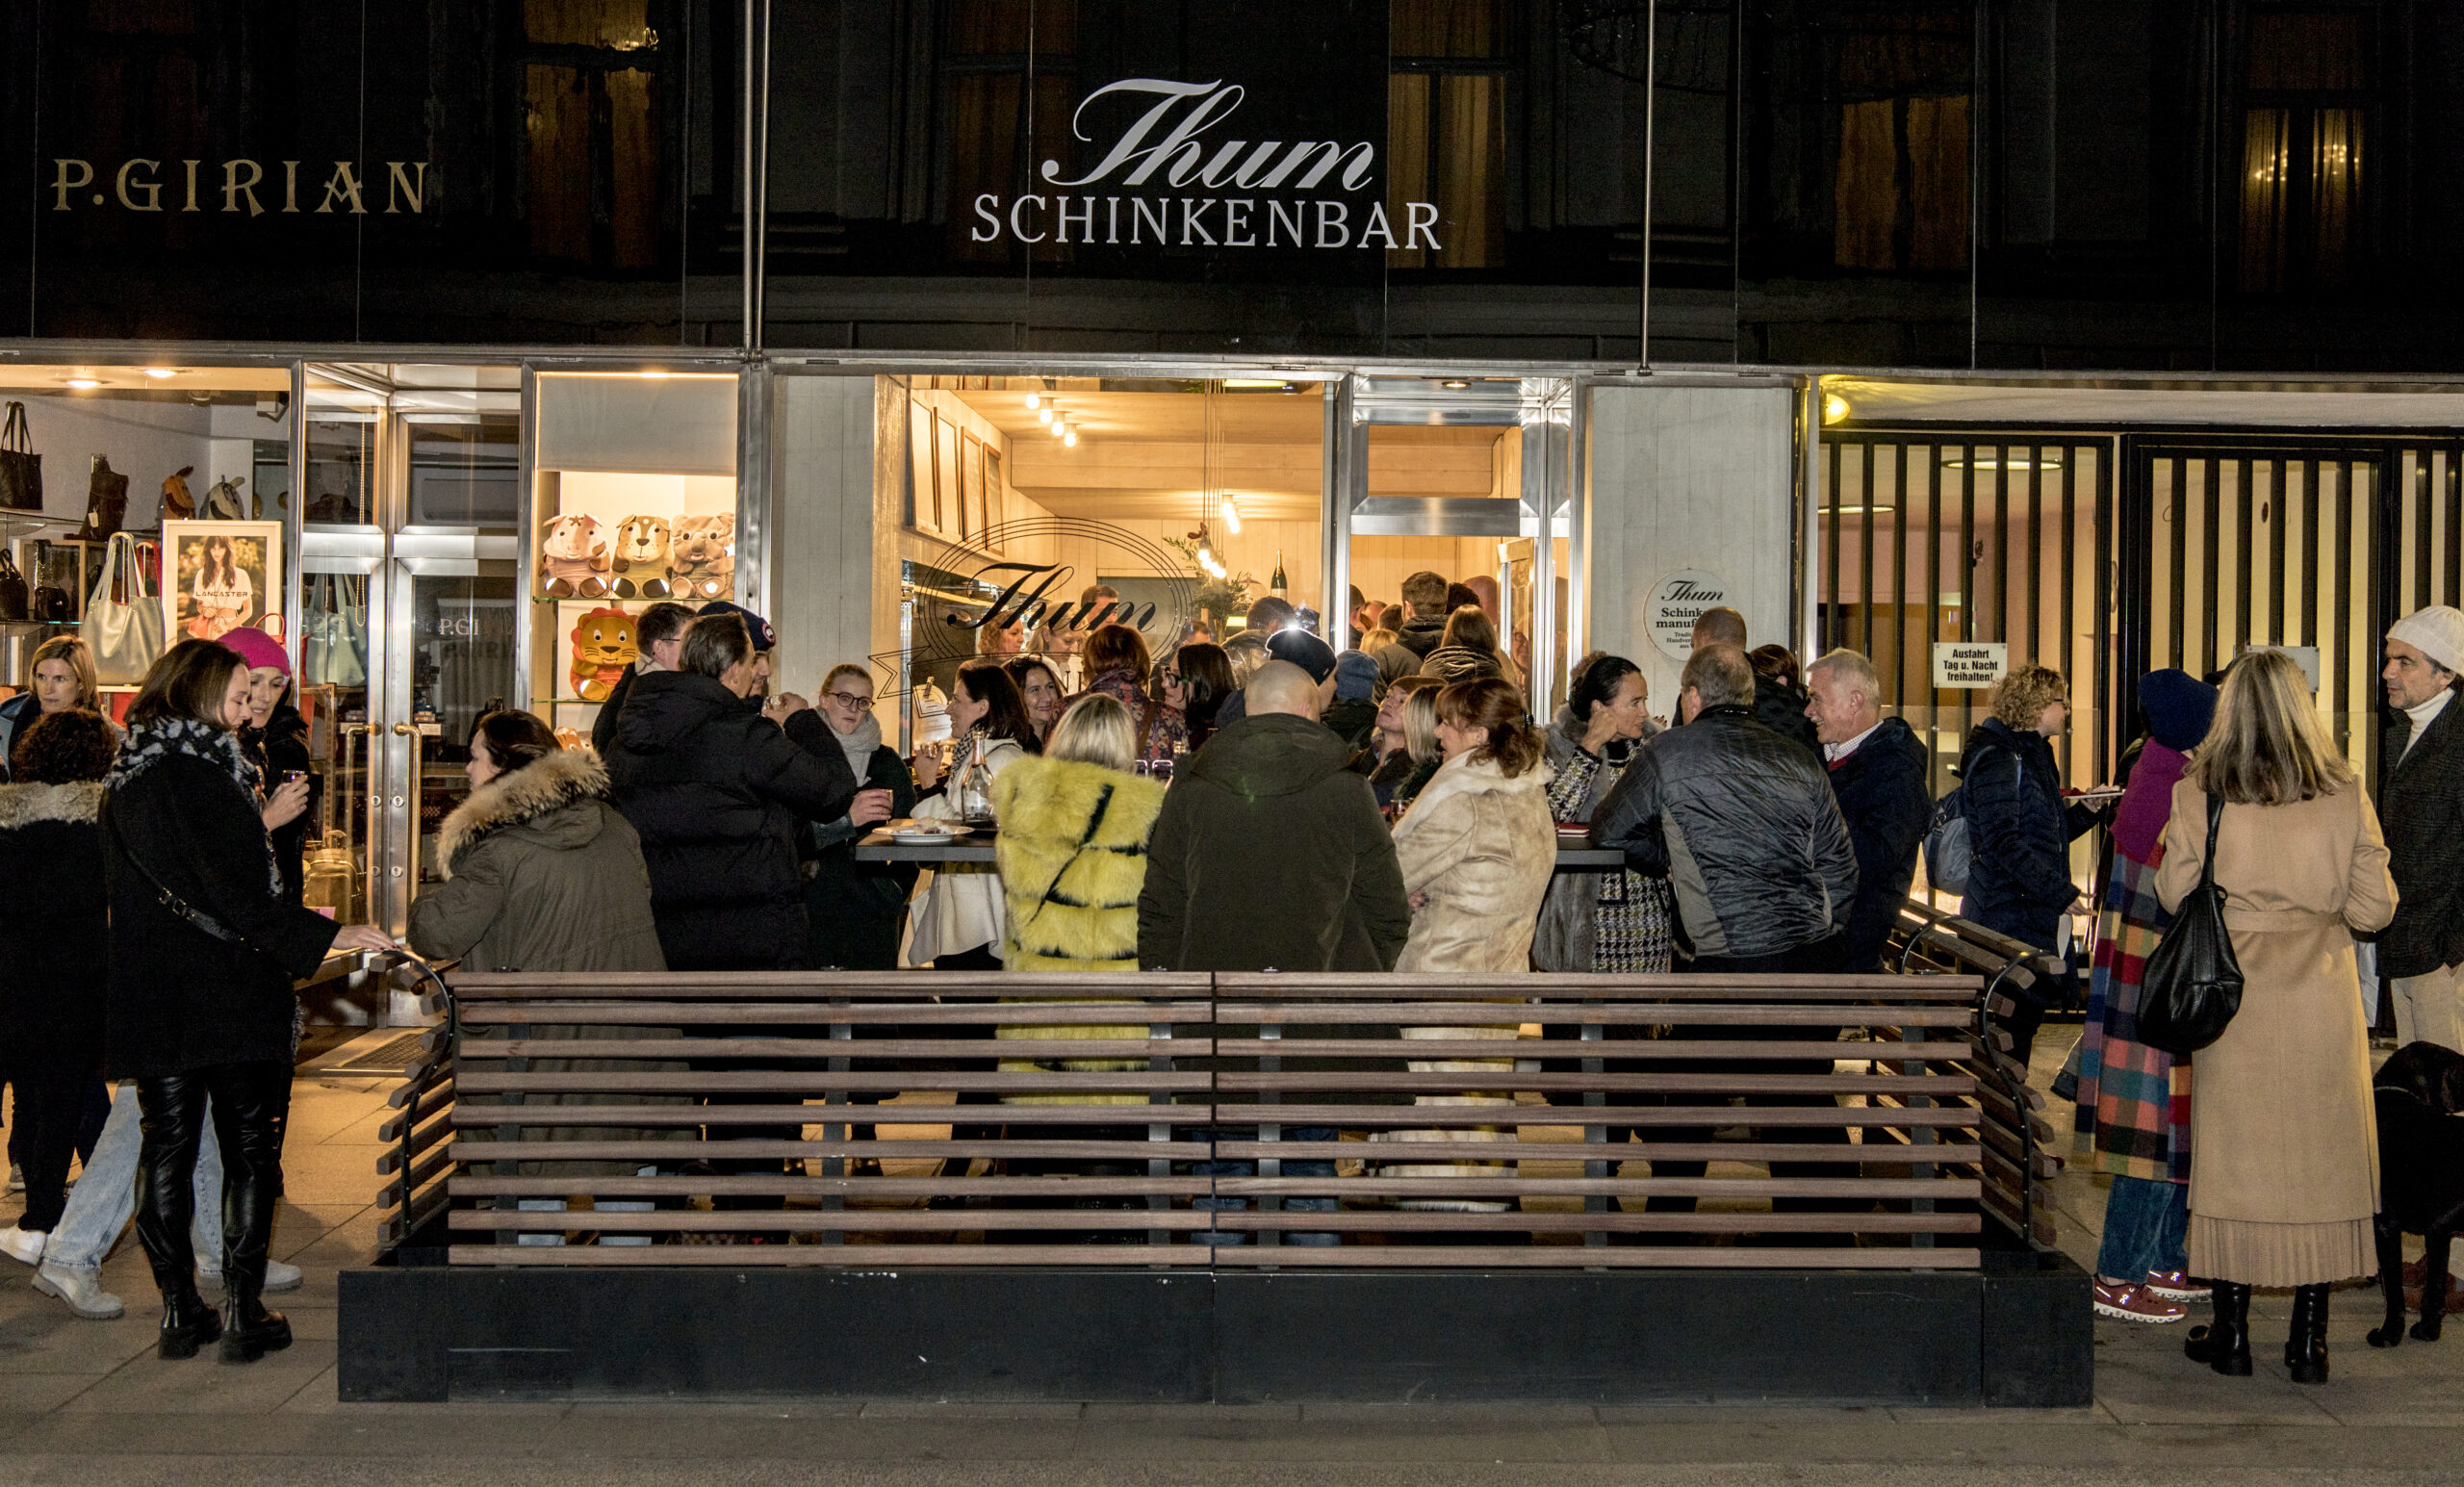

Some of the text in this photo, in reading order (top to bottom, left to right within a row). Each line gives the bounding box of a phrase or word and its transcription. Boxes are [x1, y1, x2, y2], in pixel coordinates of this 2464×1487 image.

[1041, 78, 1373, 192] Thum
[50, 158, 429, 218] P.GIRIAN
[971, 193, 1442, 250] SCHINKENBAR
[946, 562, 1157, 633] Thum
[1660, 579, 1724, 602] Thum
[1661, 607, 1703, 617] Schink
[1656, 618, 1697, 628] manuf
[1952, 649, 1989, 659] Ausfahrt
[1943, 660, 1959, 671] Tag
[1971, 660, 1998, 671] Nacht
[1947, 672, 1993, 681] freihalten!
